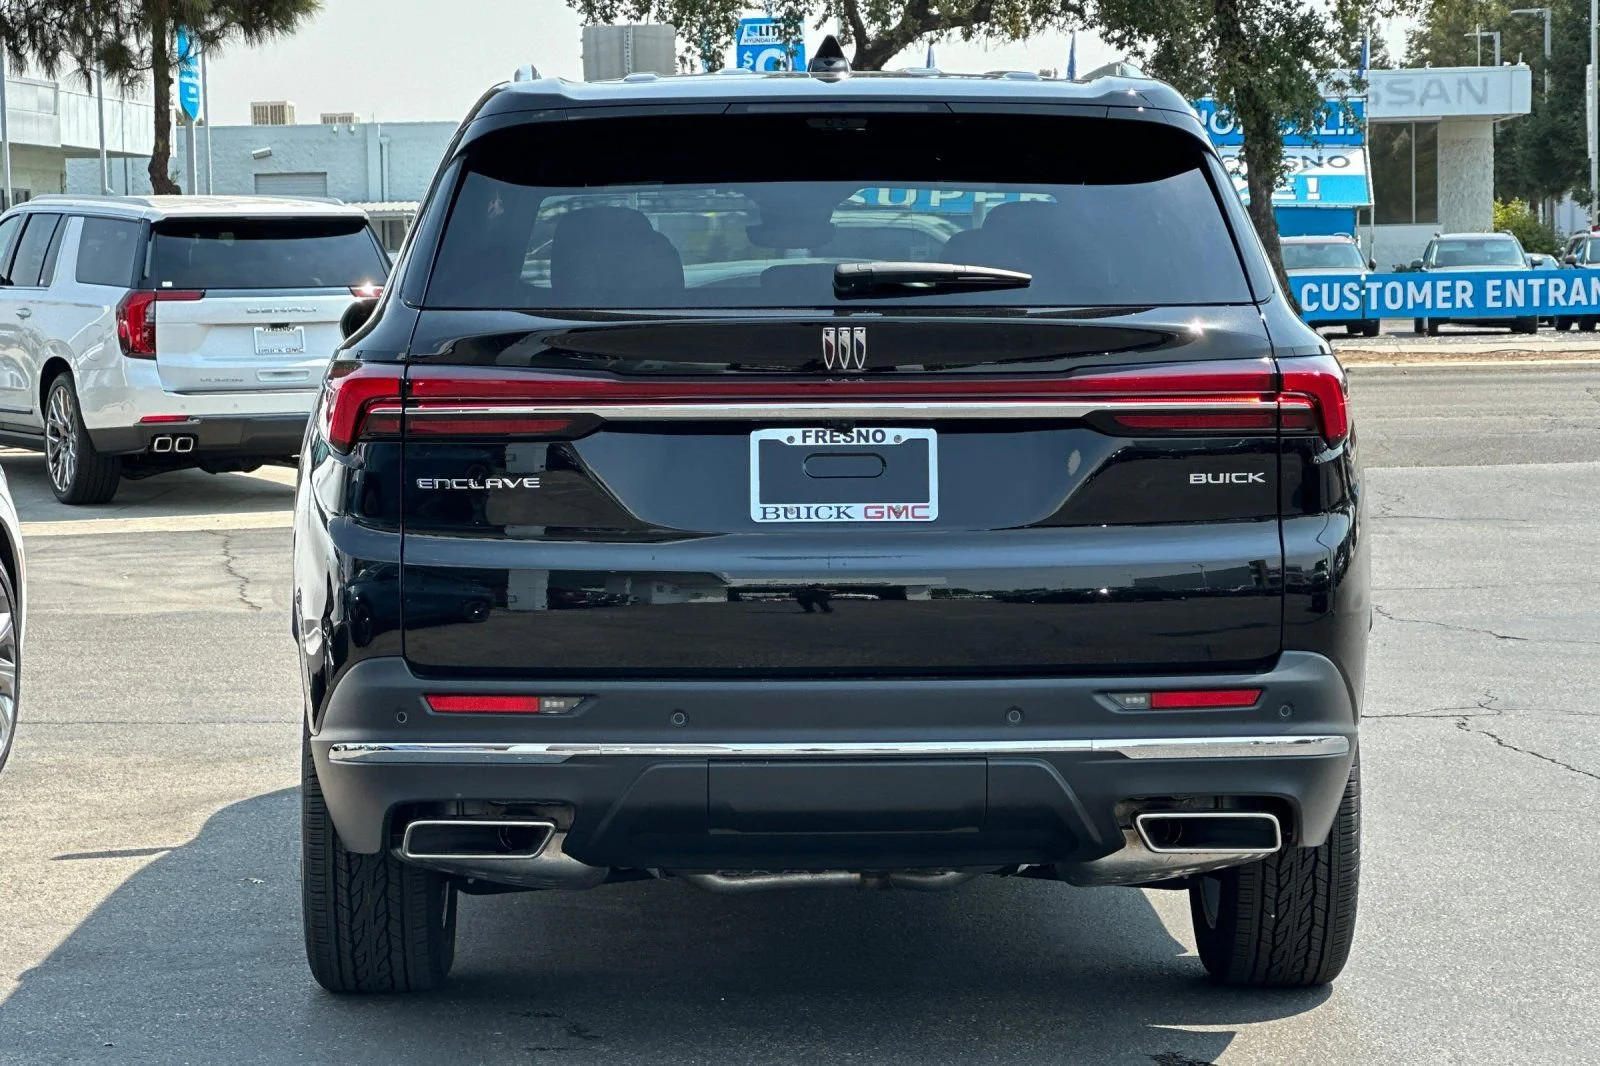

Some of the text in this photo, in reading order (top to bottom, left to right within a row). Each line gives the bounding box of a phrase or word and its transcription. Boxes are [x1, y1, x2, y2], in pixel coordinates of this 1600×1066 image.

[1301, 280, 1475, 312] CUSTOMER
[801, 429, 887, 444] FRESNO
[416, 477, 541, 490] ENCLAVE
[1189, 472, 1266, 484] BUICK
[759, 505, 930, 520] BUICK GMC
